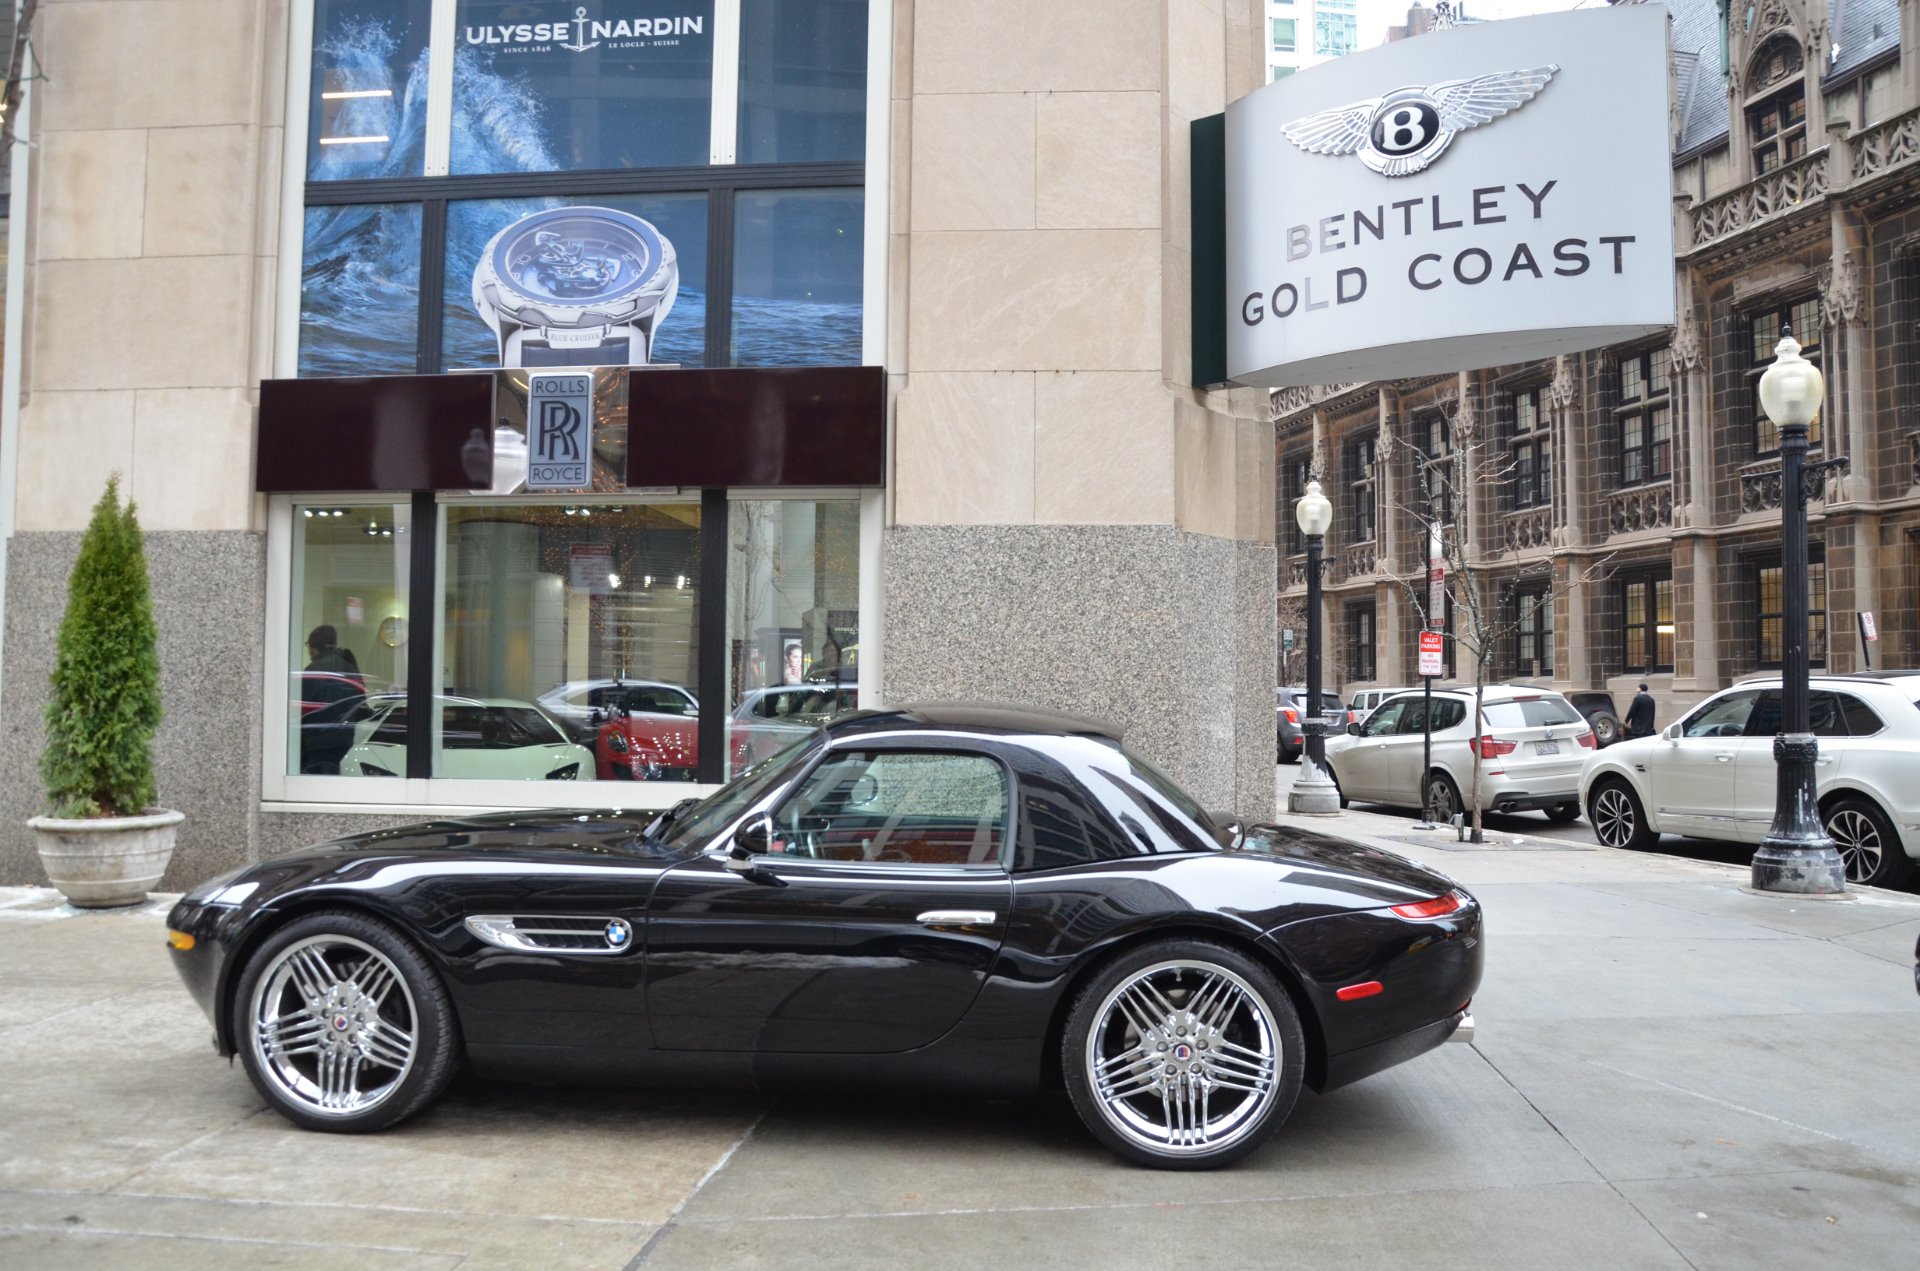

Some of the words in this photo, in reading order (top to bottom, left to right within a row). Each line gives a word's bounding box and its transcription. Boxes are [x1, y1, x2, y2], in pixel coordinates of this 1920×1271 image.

[466, 23, 570, 44] ULYSSE
[591, 16, 703, 39] NARDIN
[531, 45, 552, 53] 1846
[1286, 180, 1558, 263] BENTLEY
[1242, 266, 1368, 327] GOLD
[1408, 235, 1636, 291] COAST
[535, 380, 585, 394] ROLLS
[533, 467, 583, 481] ROYCE
